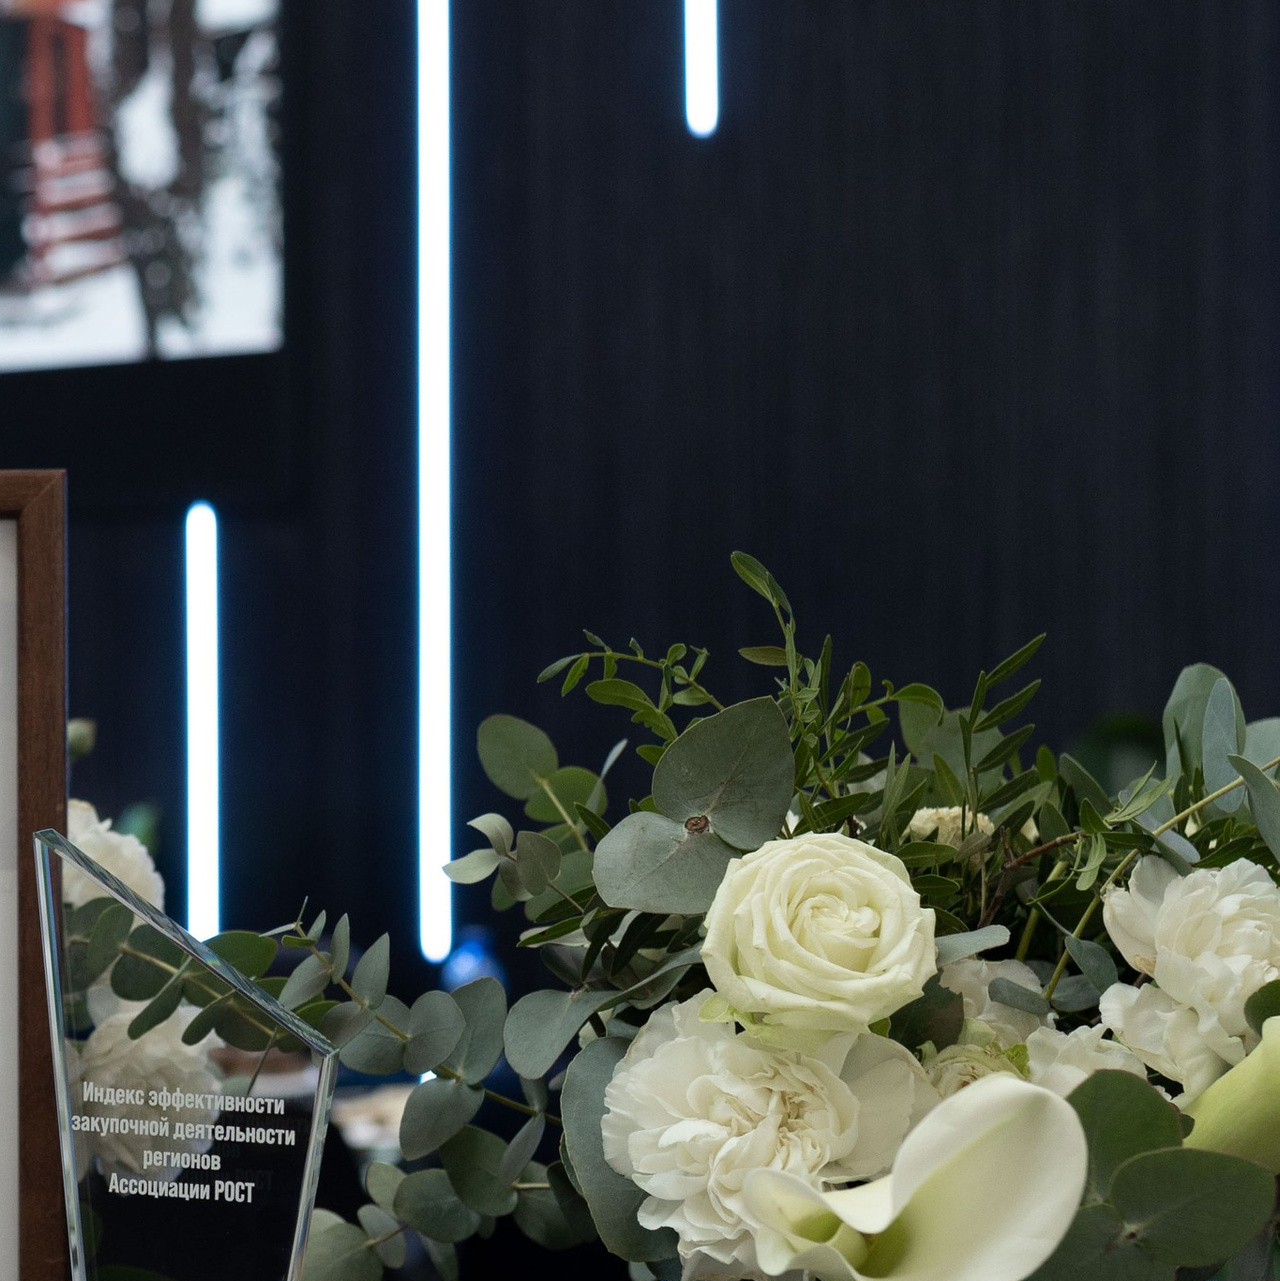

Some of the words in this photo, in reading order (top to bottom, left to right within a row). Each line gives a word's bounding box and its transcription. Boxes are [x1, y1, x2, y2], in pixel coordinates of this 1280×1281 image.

[83, 1081, 145, 1105] Индекс
[148, 1087, 284, 1114] эффективности
[72, 1115, 170, 1137] закупочной
[173, 1122, 296, 1145] деятельности
[143, 1150, 221, 1170] регионов
[108, 1173, 210, 1201] Ассоциации
[215, 1180, 255, 1203] РОСТ
